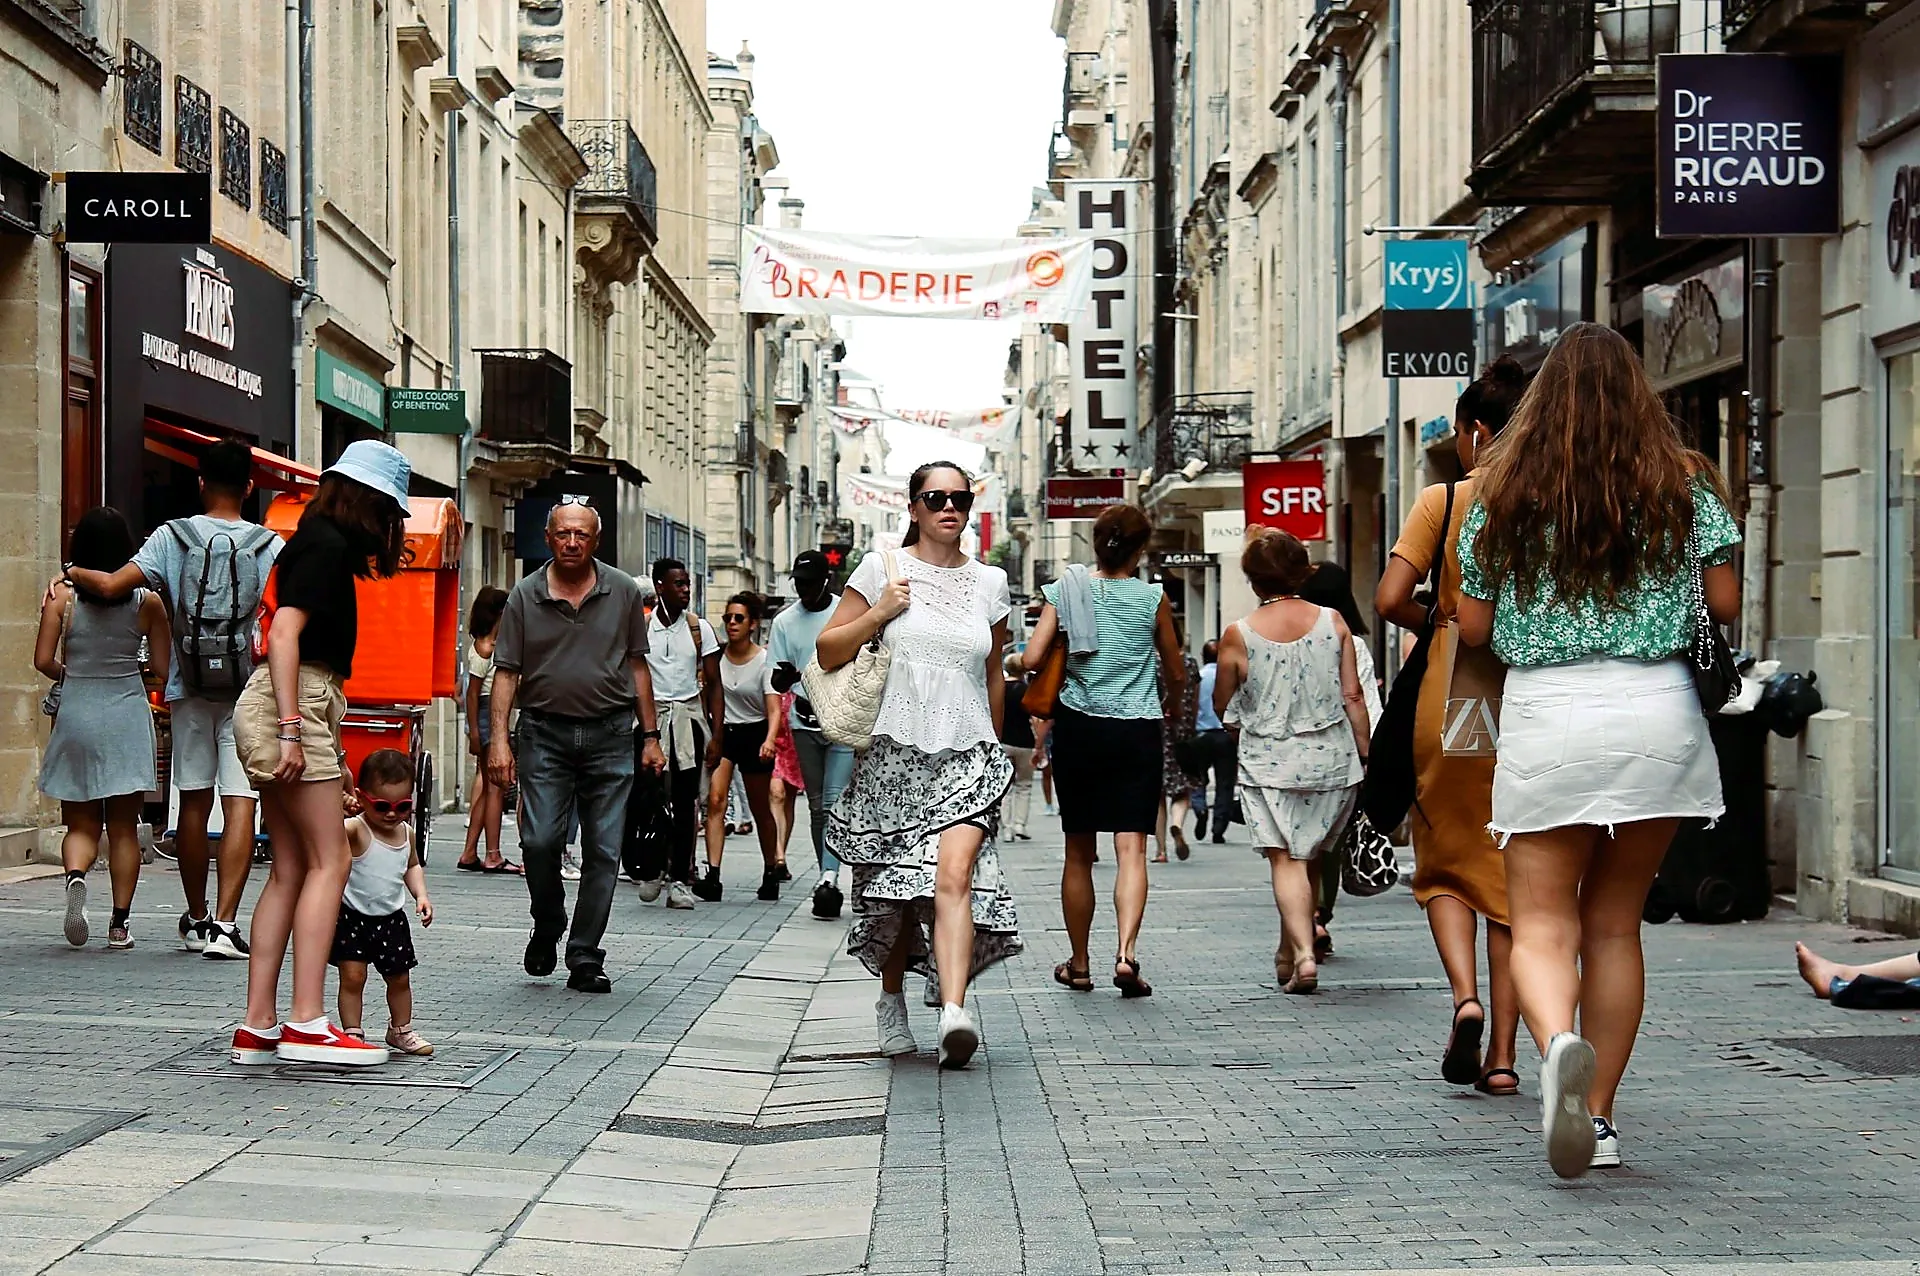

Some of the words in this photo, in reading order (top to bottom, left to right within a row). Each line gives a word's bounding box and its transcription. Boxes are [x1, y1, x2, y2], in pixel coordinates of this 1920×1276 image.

[1673, 89, 1713, 118] Dr
[1673, 122, 1803, 152] PIERRE
[1673, 156, 1826, 188] RICAUD
[83, 198, 192, 218] CAROLL
[1674, 190, 1738, 204] PARIS
[771, 262, 975, 305] BRADERIE
[1388, 261, 1456, 295] Krys
[1078, 189, 1129, 430] HOTEL
[1386, 351, 1469, 376] EKYOG
[391, 391, 422, 400] UNITED
[424, 391, 459, 401] COLORS
[391, 400, 404, 410] OF
[896, 408, 951, 430] ERIE
[853, 485, 907, 507] BRAD
[1261, 486, 1324, 516] SFR
[1210, 526, 1246, 537] PAND
[1164, 553, 1212, 564] AGATHA
[1443, 696, 1501, 751] ZA
